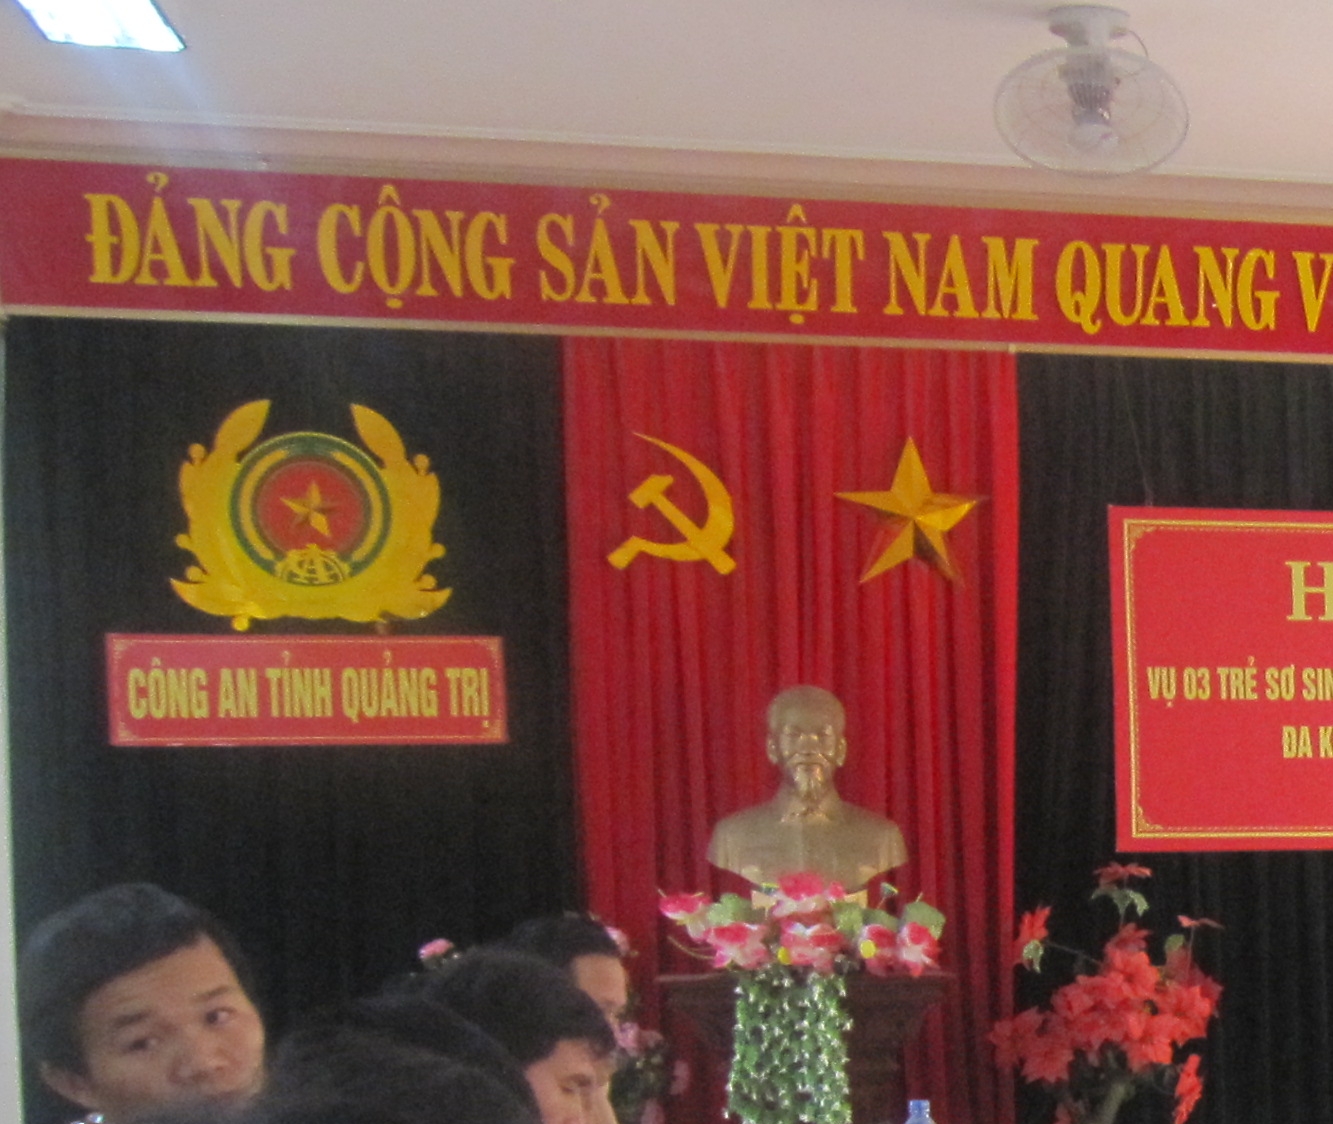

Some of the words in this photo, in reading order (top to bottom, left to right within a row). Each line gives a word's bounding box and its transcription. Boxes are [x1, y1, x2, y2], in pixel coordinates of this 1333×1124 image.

[85, 174, 295, 291] ĐẢNG
[319, 185, 515, 308] CỘNG
[537, 196, 680, 305] SẢN
[695, 205, 865, 324] VIỆT
[883, 232, 1039, 320] NAM
[1056, 241, 1280, 334] QUANG
[128, 657, 210, 719] CÔNG
[218, 668, 259, 717] AN
[265, 651, 334, 717] TỈNH
[341, 651, 439, 724] QUẢNG
[445, 667, 490, 729] TRỊ
[1147, 667, 1177, 707] VỤ
[1183, 667, 1211, 700] 03
[1216, 656, 1258, 700] TRẺ
